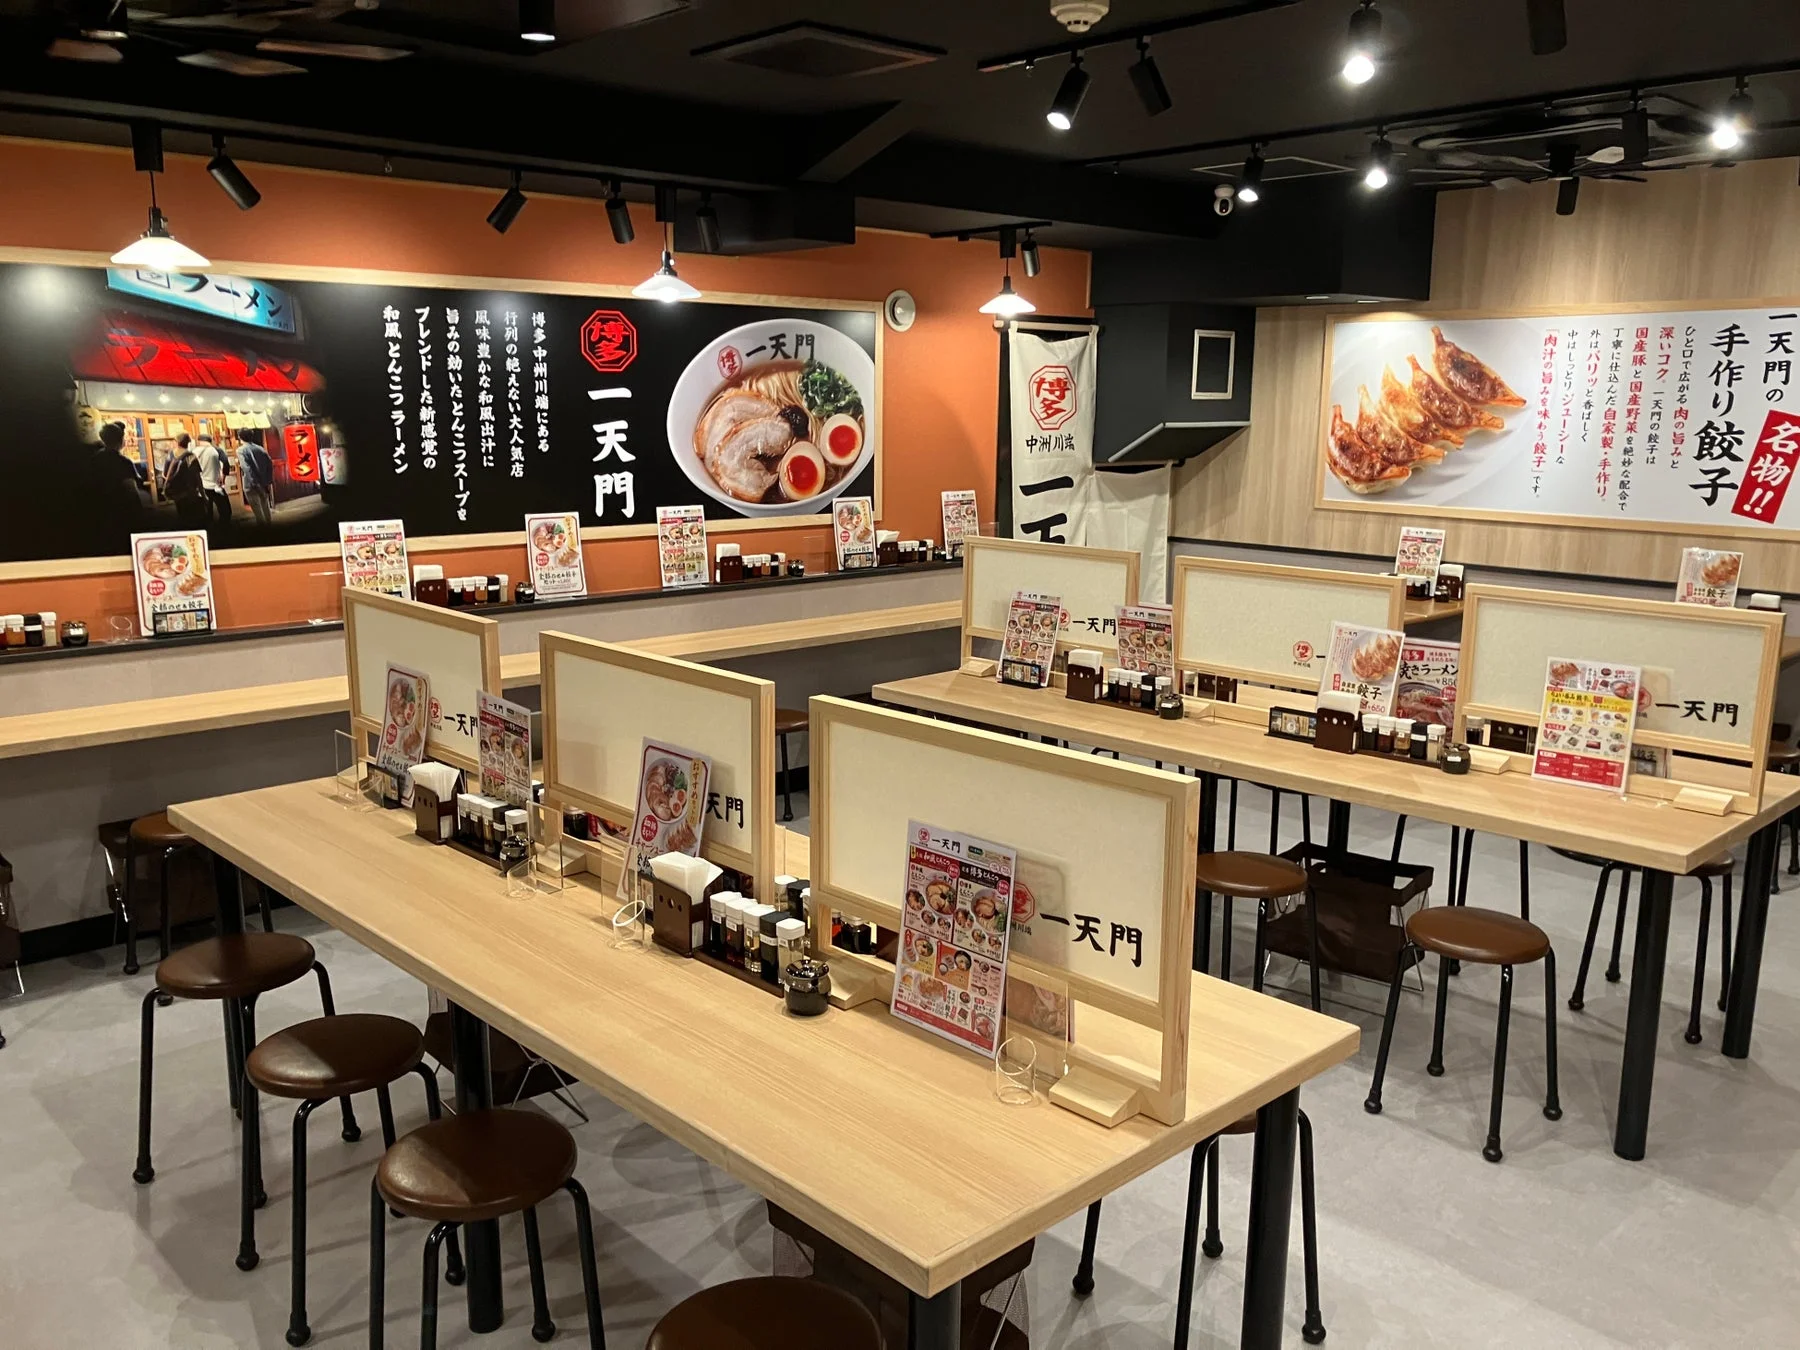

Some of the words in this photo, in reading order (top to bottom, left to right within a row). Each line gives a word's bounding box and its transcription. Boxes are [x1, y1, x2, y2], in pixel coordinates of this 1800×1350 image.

[383, 304, 409, 475] 和風とんこつラーメン
[474, 310, 496, 468] 風味豊かな和風出汁に
[503, 311, 525, 478] 行列の絶えない大人気店
[531, 311, 550, 453] 博多中州川端にある
[590, 321, 630, 363] 博多
[746, 333, 815, 361] 一天門
[1035, 376, 1072, 422] 博多
[1555, 330, 1579, 465] 中はしっとりジューシーな
[1580, 328, 1601, 443] 外はパリッと香ばしく
[1670, 325, 1697, 470] ひと口で広がる肉の旨みと
[1763, 313, 1798, 403] 一天門の
[289, 429, 314, 477] ラーメン
[445, 307, 470, 521] 旨みの効いたとんこつスープを
[587, 387, 637, 518] 一天門
[1617, 327, 1649, 512] 国産豚と国産野菜を絶妙な配合で
[1688, 323, 1749, 507] 手作り餃子
[1072, 617, 1116, 636] 一天門
[1357, 683, 1382, 700] 餃子
[1655, 700, 1739, 727] 一天門
[931, 838, 961, 853] 一天門
[1039, 912, 1143, 968] 一天門
